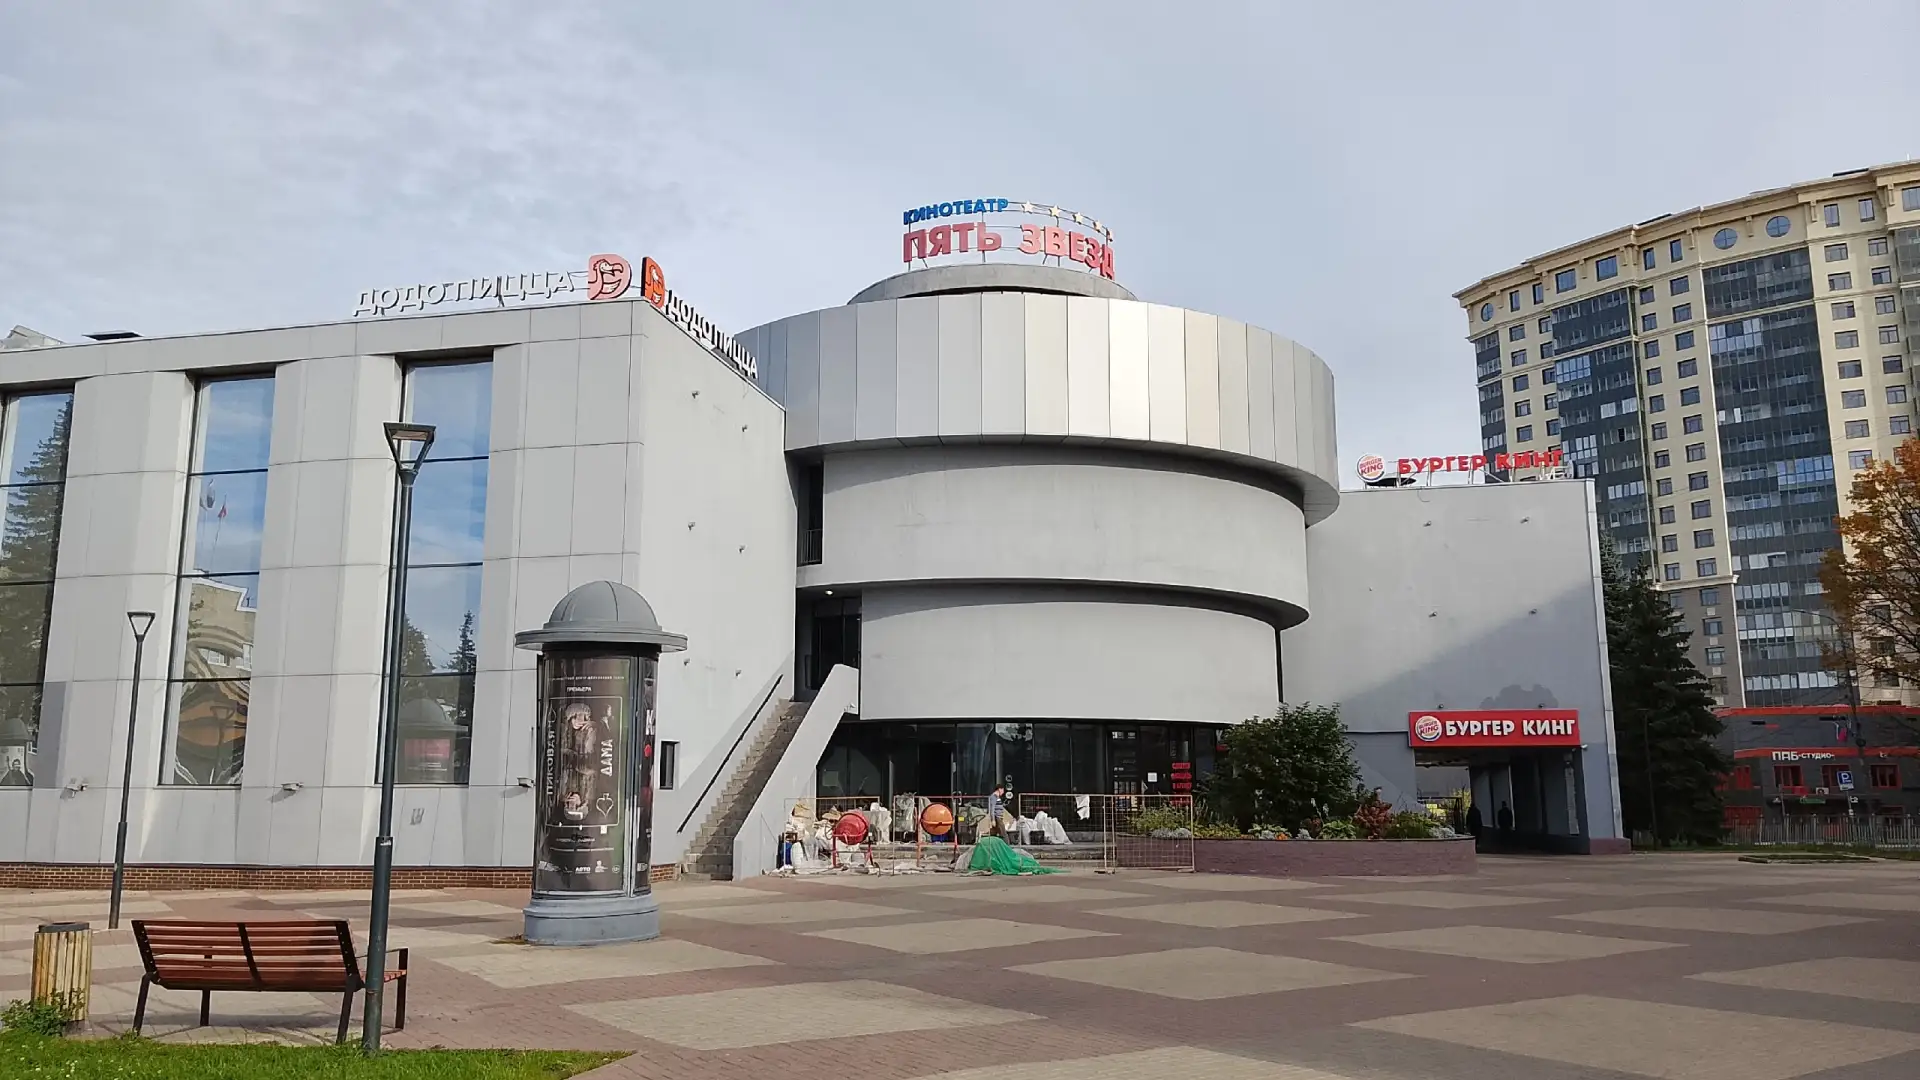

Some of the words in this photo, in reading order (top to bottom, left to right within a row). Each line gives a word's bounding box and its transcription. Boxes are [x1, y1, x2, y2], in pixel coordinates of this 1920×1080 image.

[903, 197, 1009, 225] КИНОТЕАТР
[903, 222, 1002, 263] ПЯТЬ
[1018, 223, 1116, 281] ЗВЕЗД
[1361, 462, 1384, 476] KING
[1398, 455, 1488, 475] БУРГЕР
[1496, 449, 1564, 470] КИНГ
[1420, 724, 1440, 736] KING
[1445, 720, 1516, 737] БУРГЕР
[1523, 719, 1576, 736] КИНГ
[600, 739, 614, 777] ДАМА
